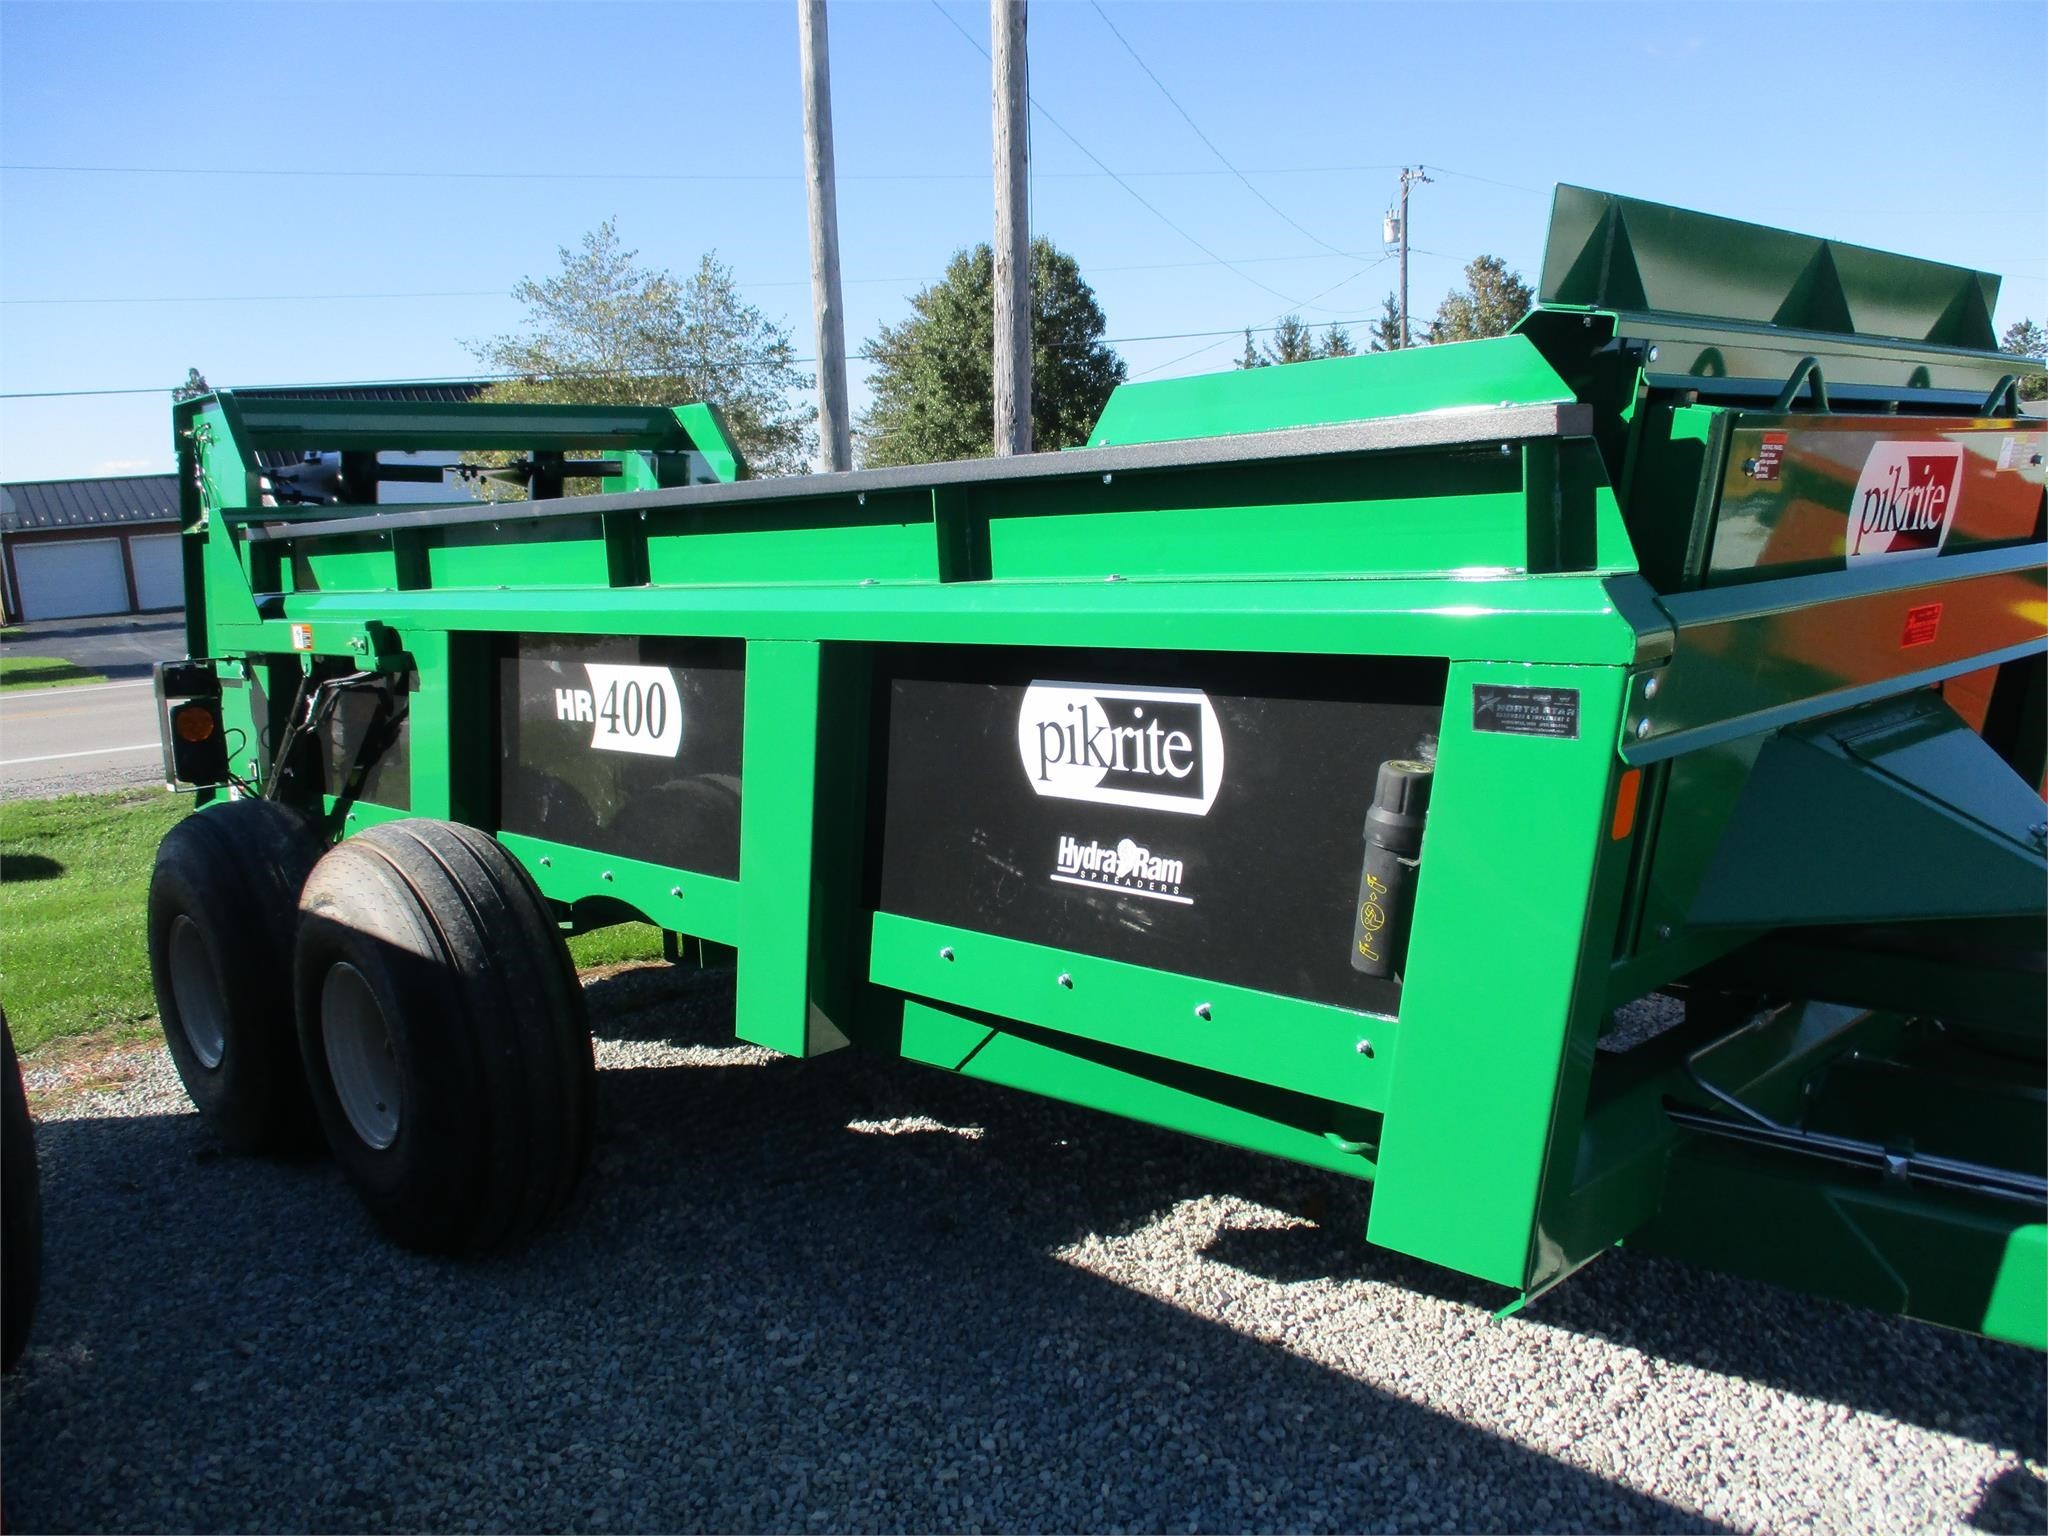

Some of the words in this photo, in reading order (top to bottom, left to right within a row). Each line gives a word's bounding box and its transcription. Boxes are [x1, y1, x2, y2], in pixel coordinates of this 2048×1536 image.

[1850, 464, 1947, 557] pikrite
[554, 688, 595, 723] HR
[600, 679, 667, 739] 400
[1035, 702, 1195, 782] pikrite
[1080, 870, 1180, 895] SPREADERS
